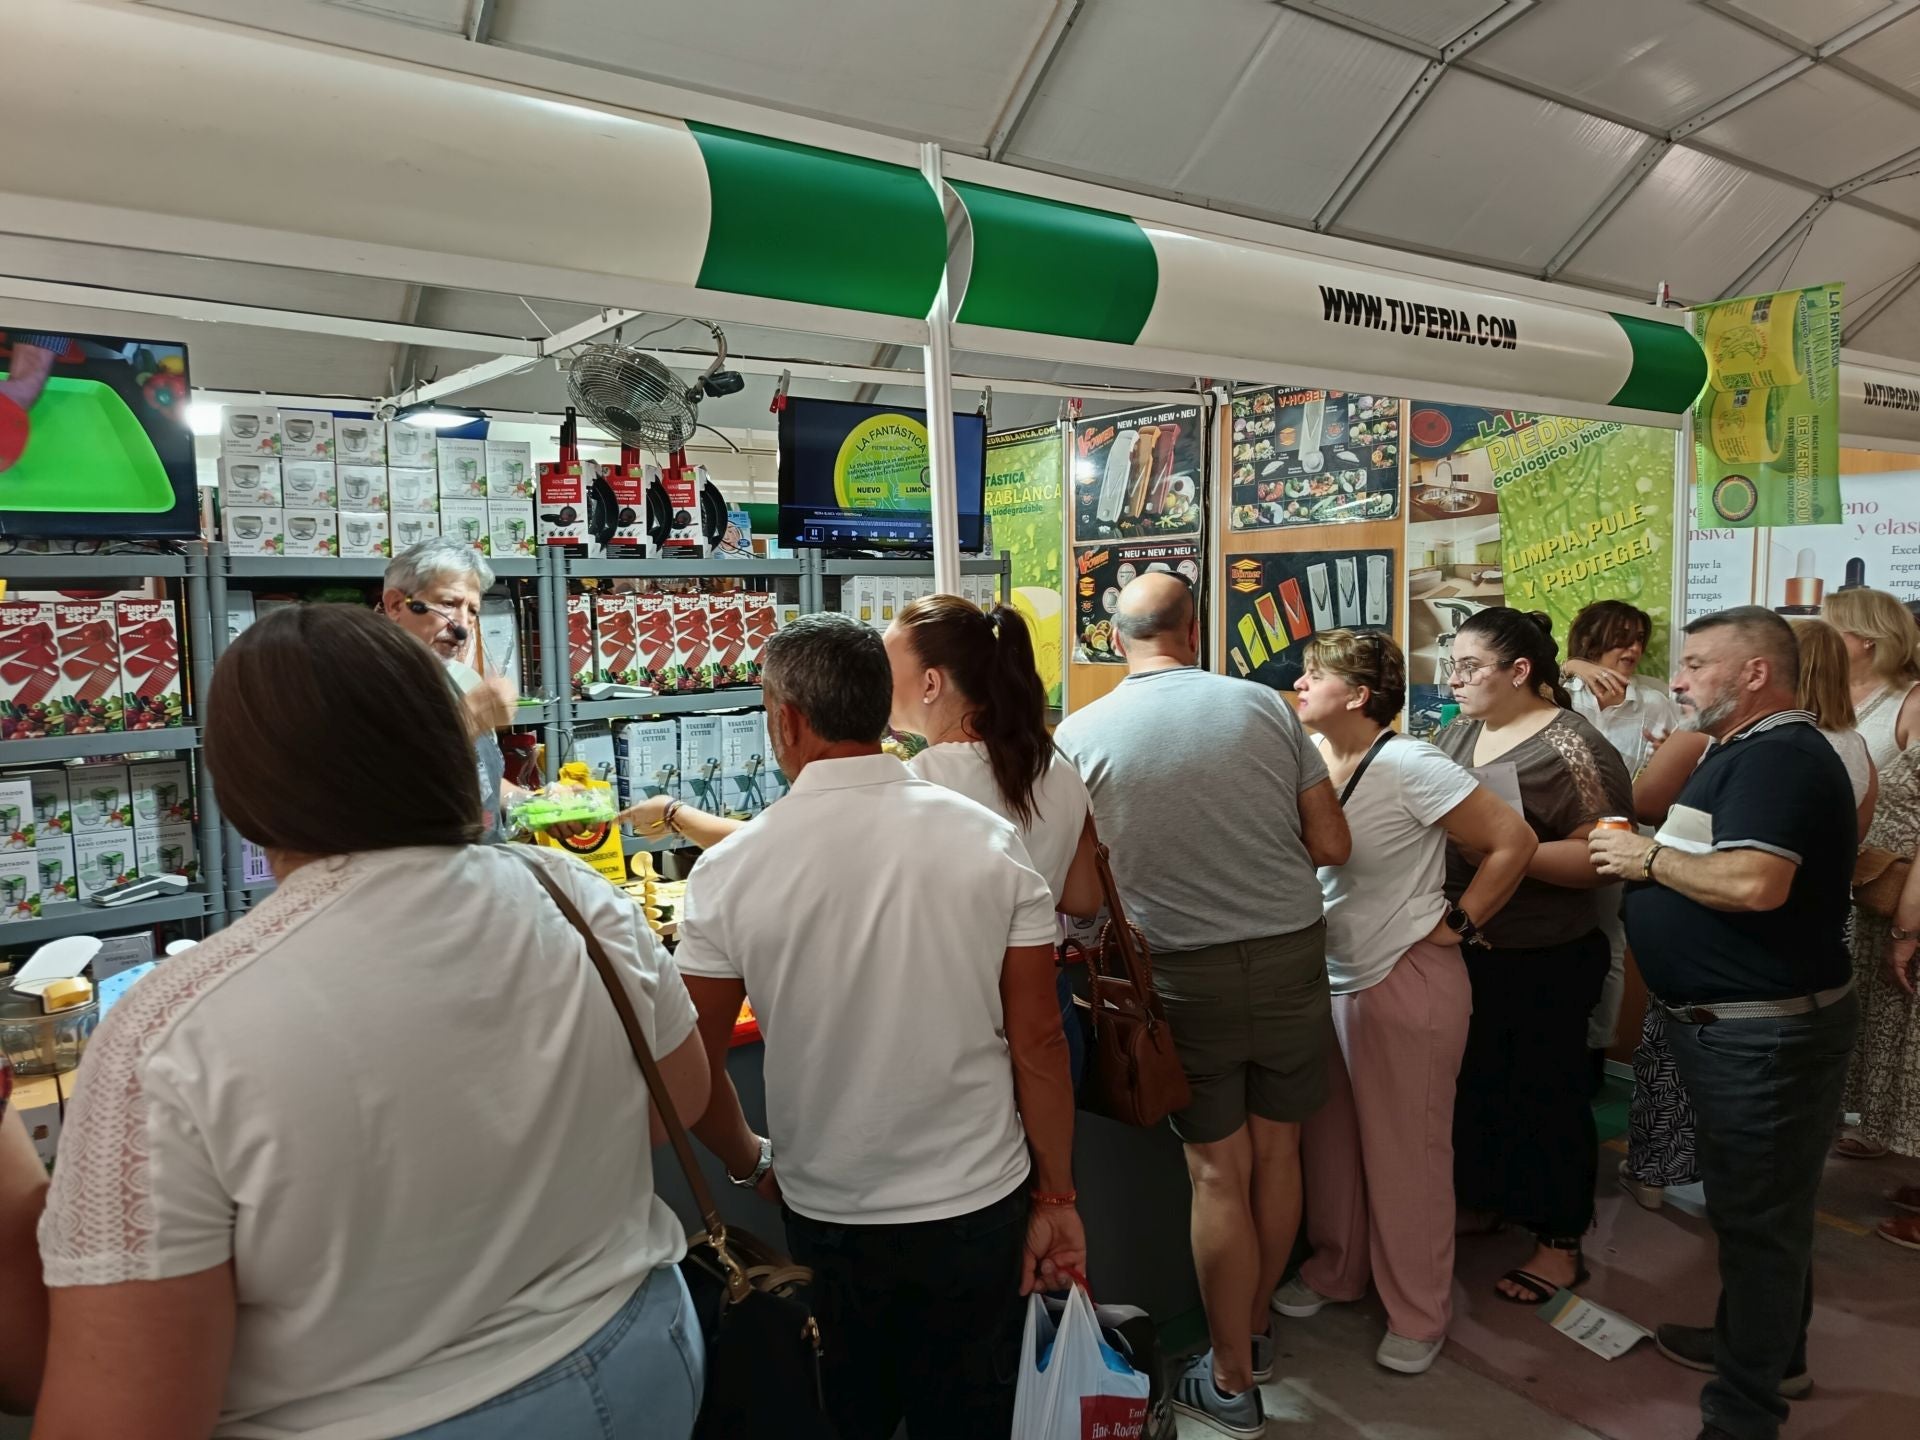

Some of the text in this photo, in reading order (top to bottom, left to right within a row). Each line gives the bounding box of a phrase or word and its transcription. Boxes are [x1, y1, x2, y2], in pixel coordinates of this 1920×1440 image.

[1829, 291, 1840, 308] LA
[1319, 285, 1517, 350] WWW.TUFERIA.COM
[1279, 390, 1326, 407] V-HOBEL
[1117, 409, 1196, 429] NEW NEU NEW NEU
[1479, 415, 1508, 439] LA
[1797, 416, 1808, 436] DE
[856, 424, 927, 453] LA FANTÁSTICA
[1493, 444, 1568, 489] ecologico
[1572, 440, 1580, 453] y
[1797, 438, 1808, 485] VENTA
[1855, 523, 1871, 540] y
[1124, 547, 1191, 558] NEU NEW NEU
[1523, 534, 1653, 600] Y PROTEGE!
[1713, 560, 1721, 569] la
[56, 605, 98, 616] Super
[119, 603, 158, 614] Super
[128, 612, 151, 621] Set
[3, 616, 28, 625] Set
[66, 613, 89, 623] Set
[638, 727, 671, 736] VEGETABLE
[686, 722, 716, 730] VEGETABLE
[728, 719, 758, 728] VEGETABLE
